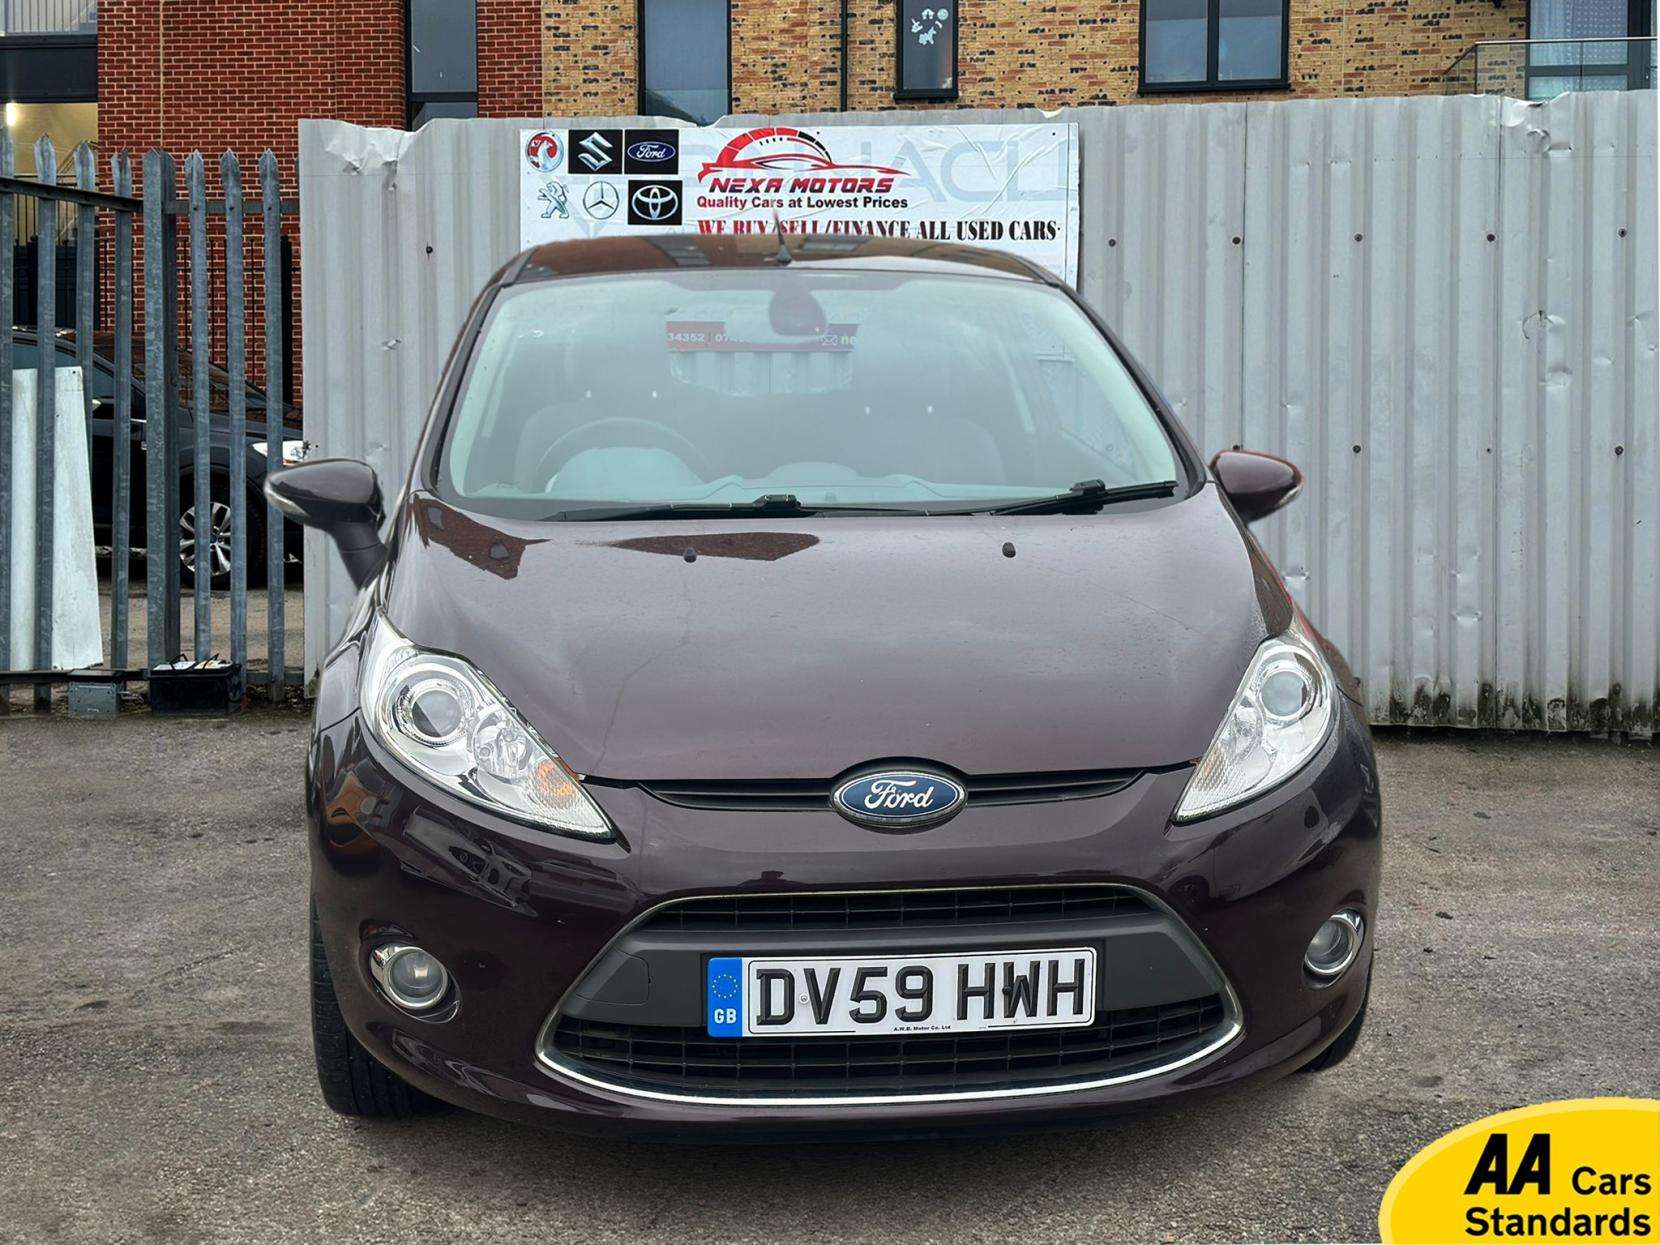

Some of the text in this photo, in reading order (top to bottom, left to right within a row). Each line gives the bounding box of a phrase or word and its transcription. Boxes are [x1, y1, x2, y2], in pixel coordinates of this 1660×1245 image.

[636, 144, 666, 159] Ford
[709, 178, 895, 193] NEXA MOTORS
[697, 196, 908, 211] Quality Cars at Lowest Prices
[697, 220, 727, 235] WE
[917, 221, 951, 241] ALL
[957, 221, 1004, 241] USED
[864, 780, 935, 809] Ford
[714, 958, 1085, 1026] GB DV59 HWH
